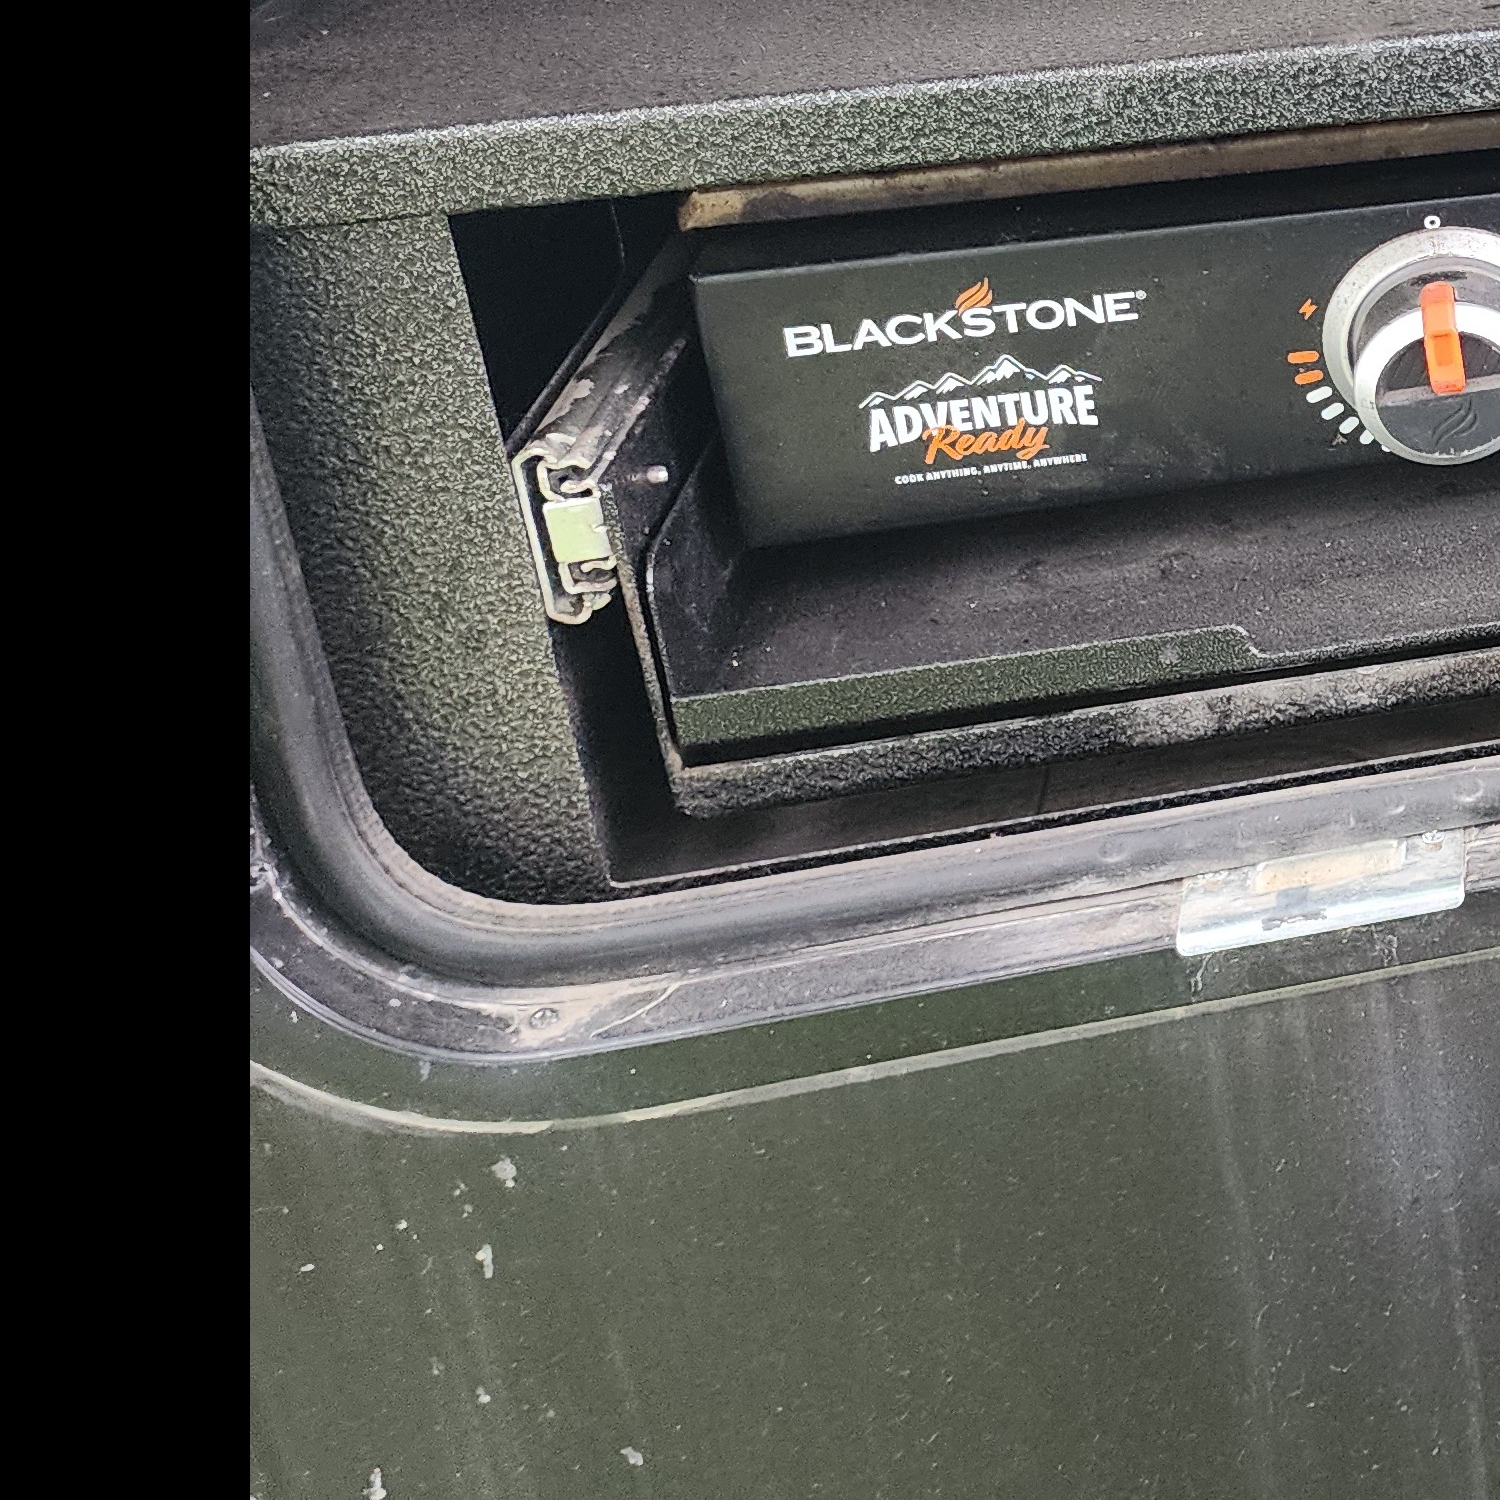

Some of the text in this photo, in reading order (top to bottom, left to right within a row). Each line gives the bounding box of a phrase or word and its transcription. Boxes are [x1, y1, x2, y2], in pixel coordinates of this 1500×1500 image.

[783, 291, 1140, 357] BLACKSTONE
[870, 385, 1099, 452] ADVENTURE
[923, 419, 1051, 465] Ready
[894, 473, 925, 485] COOK
[926, 466, 982, 482] ANYTHING,
[1033, 453, 1088, 468] ANYWHERE
